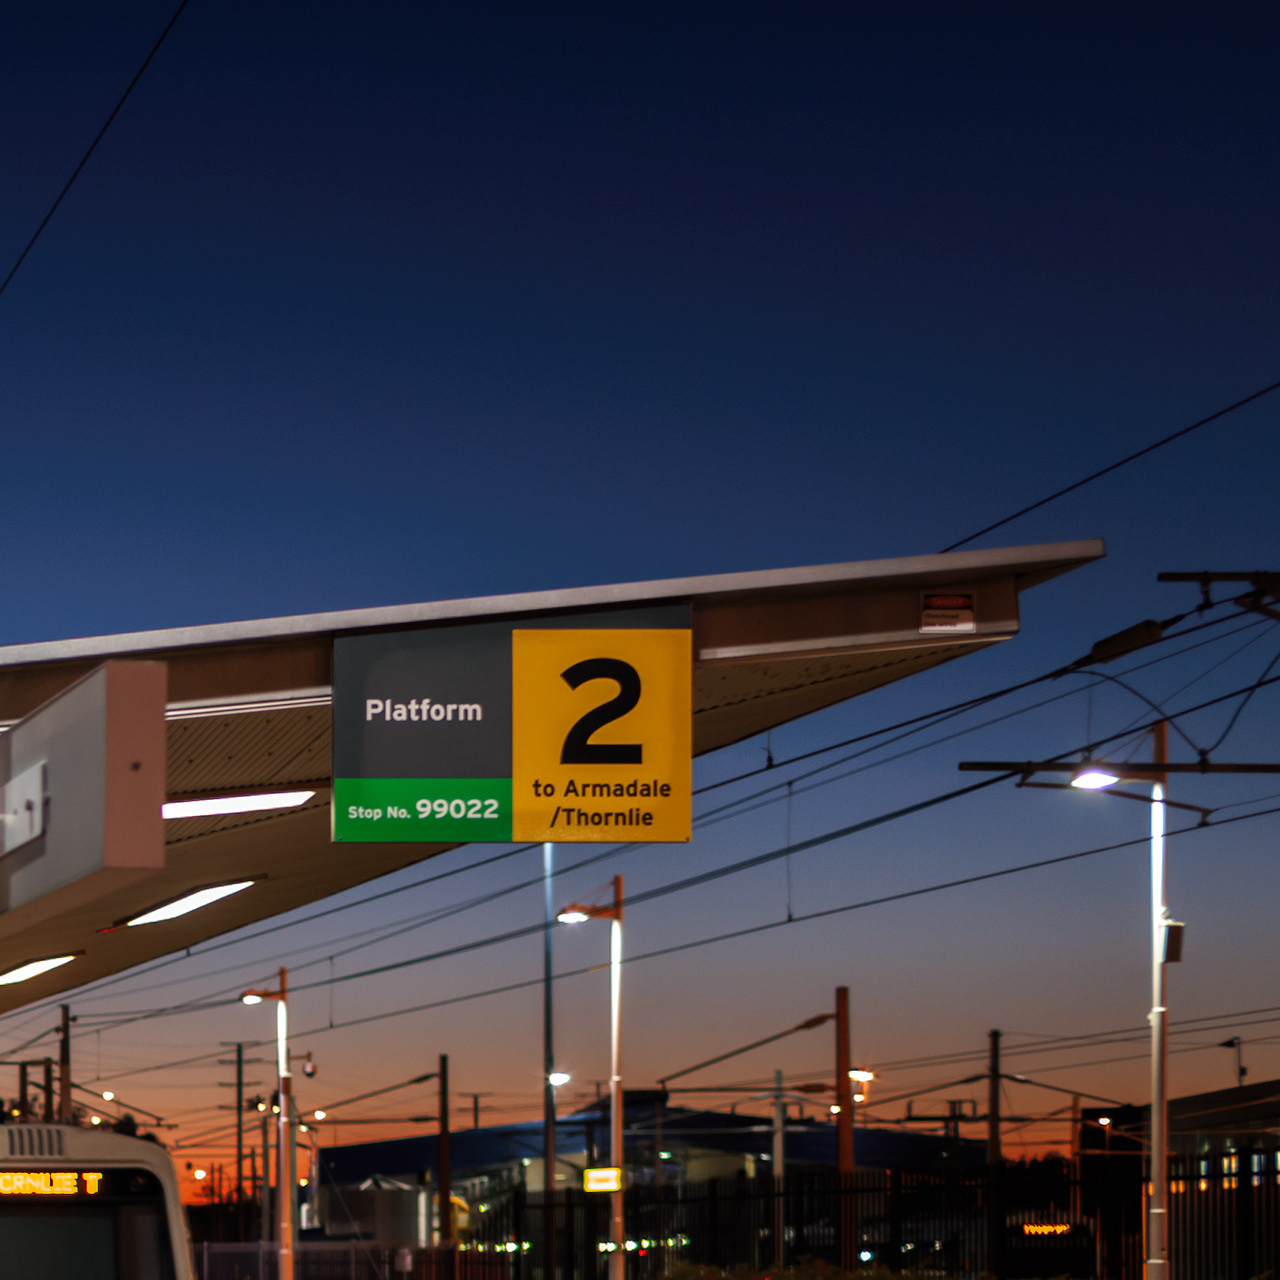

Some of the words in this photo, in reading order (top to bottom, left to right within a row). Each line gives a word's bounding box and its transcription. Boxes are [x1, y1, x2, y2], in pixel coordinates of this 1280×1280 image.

[365, 698, 482, 722] Platform
[559, 657, 643, 765] 2
[532, 779, 555, 797] to
[564, 779, 672, 798] Armadale
[348, 805, 382, 821] Stop
[386, 805, 411, 819] No.
[415, 798, 500, 820] 99022
[549, 806, 654, 828] /Thornlie
[81, 1172, 103, 1195] T
